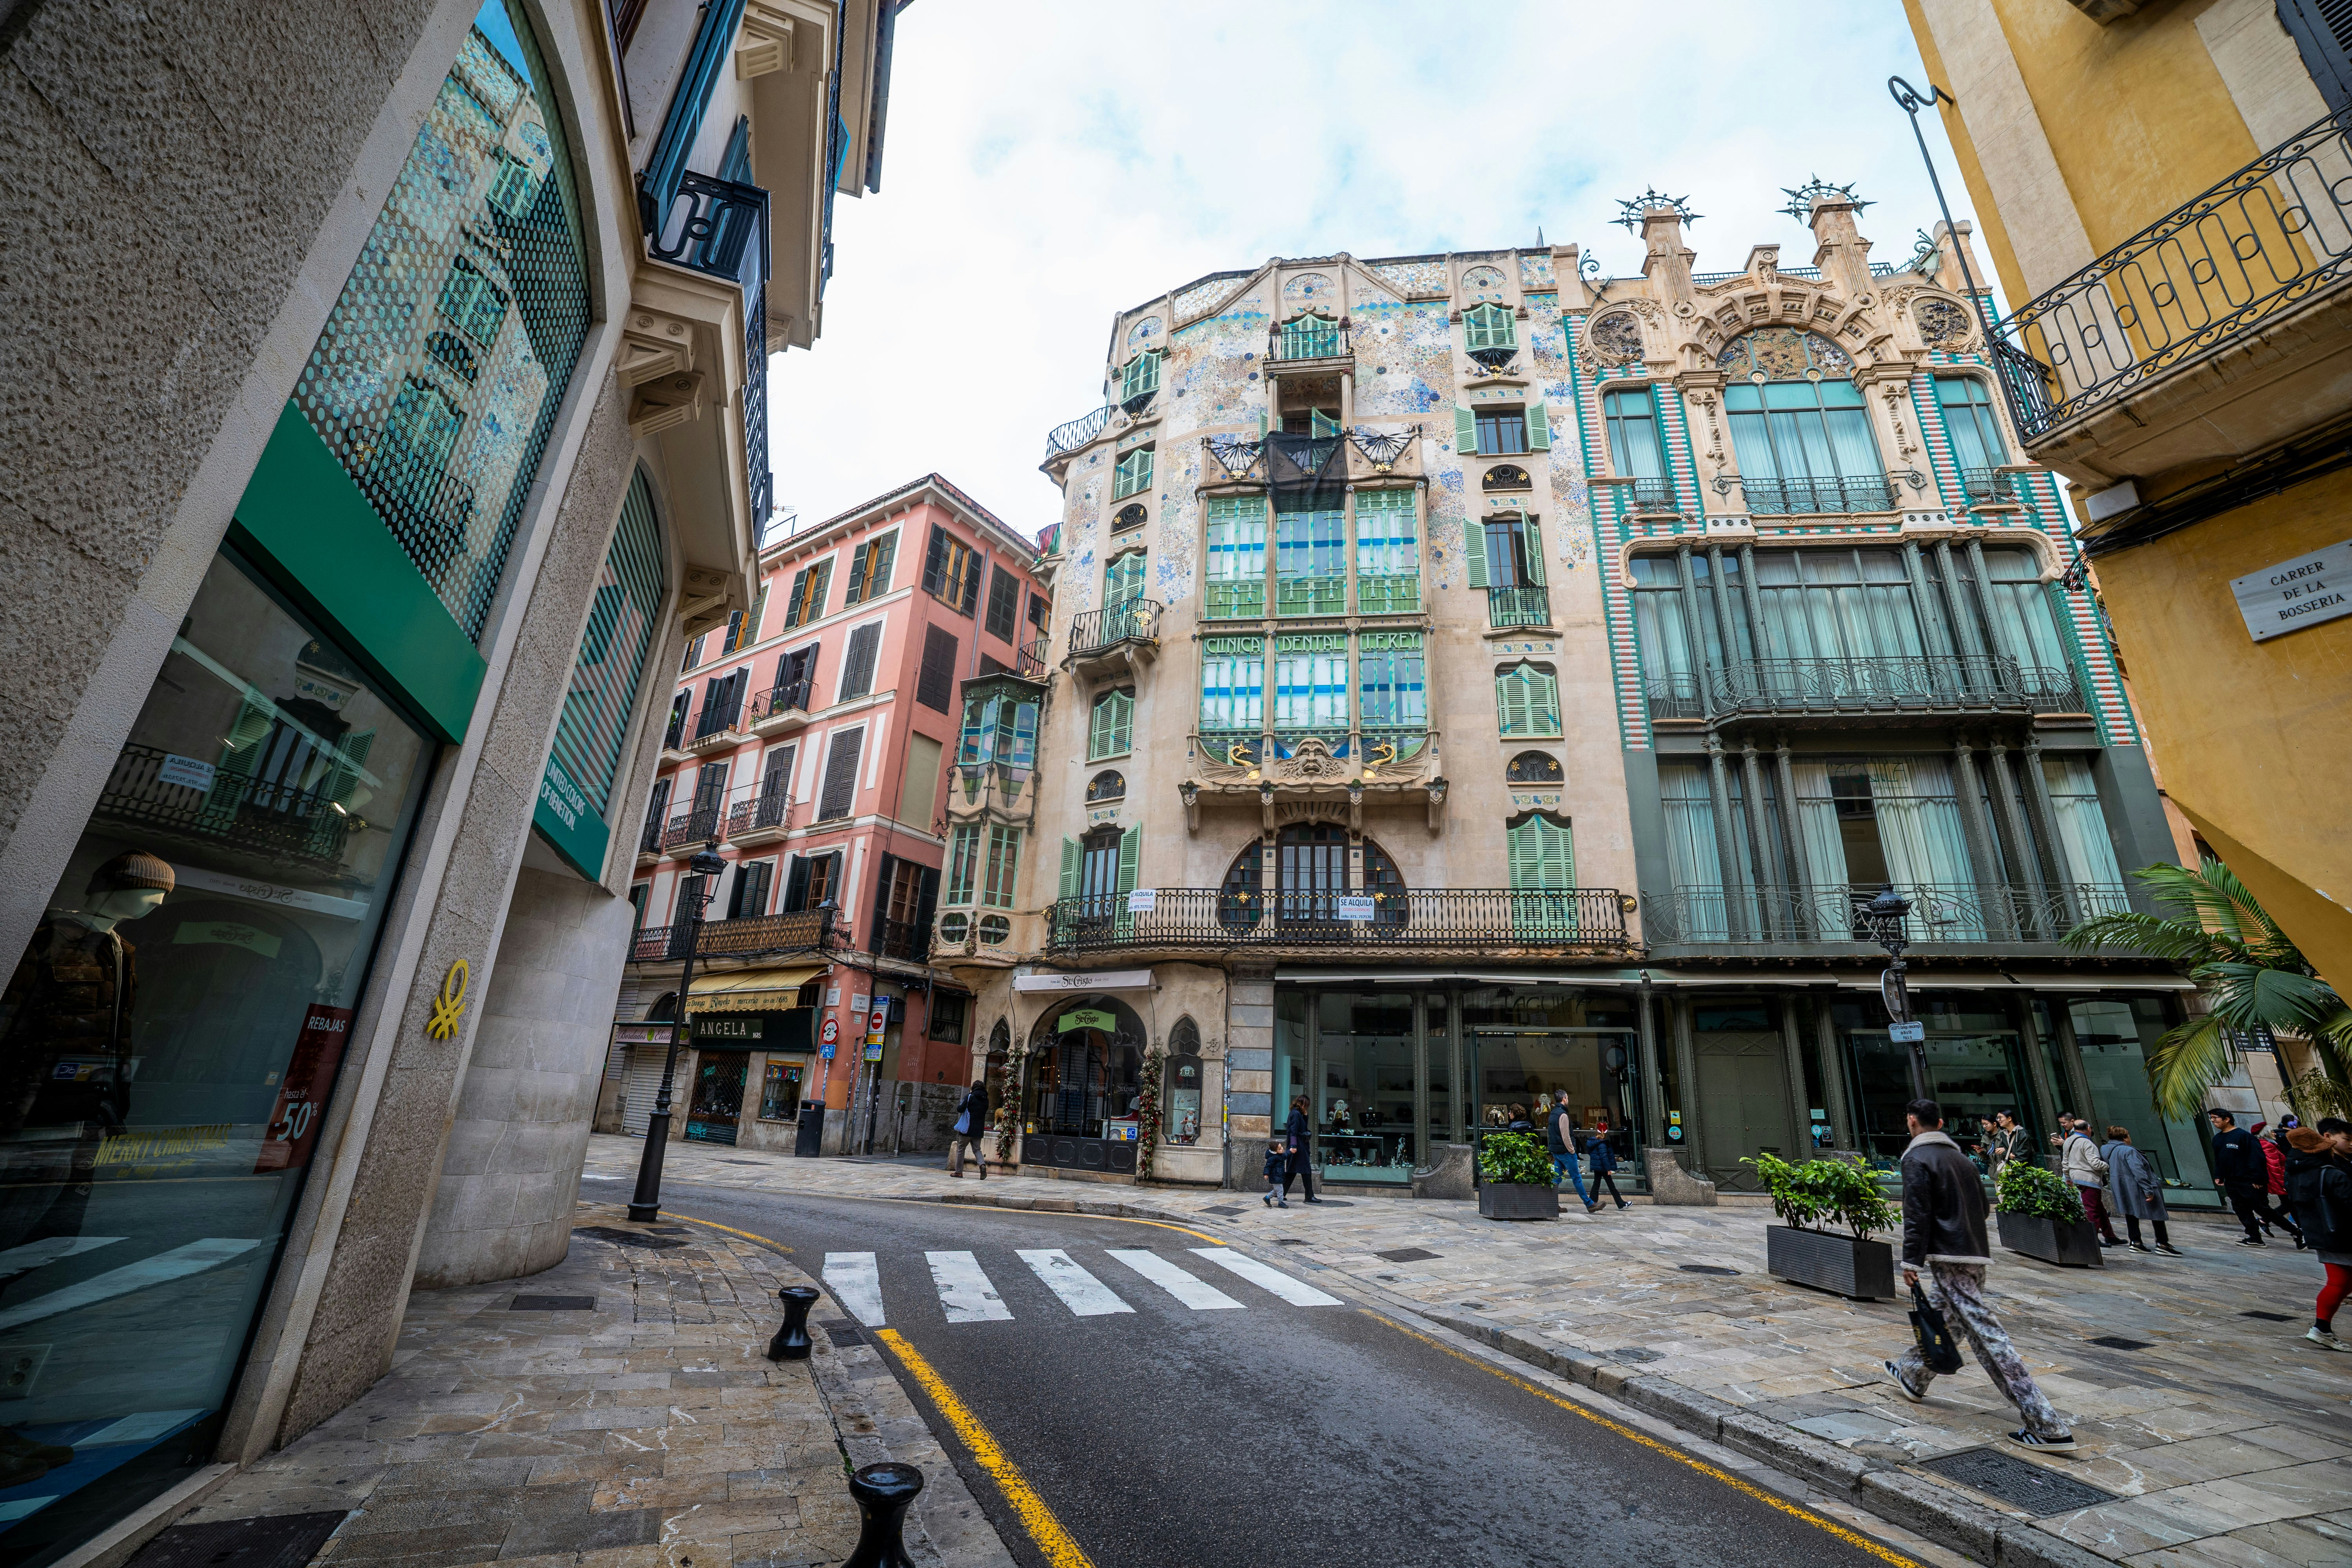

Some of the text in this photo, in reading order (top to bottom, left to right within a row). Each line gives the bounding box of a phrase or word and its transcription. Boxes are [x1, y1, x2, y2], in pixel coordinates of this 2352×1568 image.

[2270, 561, 2325, 586] CARRER
[2283, 581, 2326, 601] DE LA
[2278, 593, 2346, 621] BOSSERIA
[1206, 637, 1260, 653] CLINICA
[1282, 634, 1343, 652] DENTAL
[541, 781, 552, 800] OF
[547, 759, 585, 817] UNITED COLORS
[1073, 975, 1093, 987] Cristo
[307, 1016, 346, 1033] REBAJAS
[700, 1022, 746, 1035] ANGELA
[1084, 1014, 1099, 1024] Cristo
[618, 1029, 646, 1040] Bordados
[284, 1087, 306, 1099] hasta el
[93, 1123, 232, 1167] MERRY CHRISTMAS
